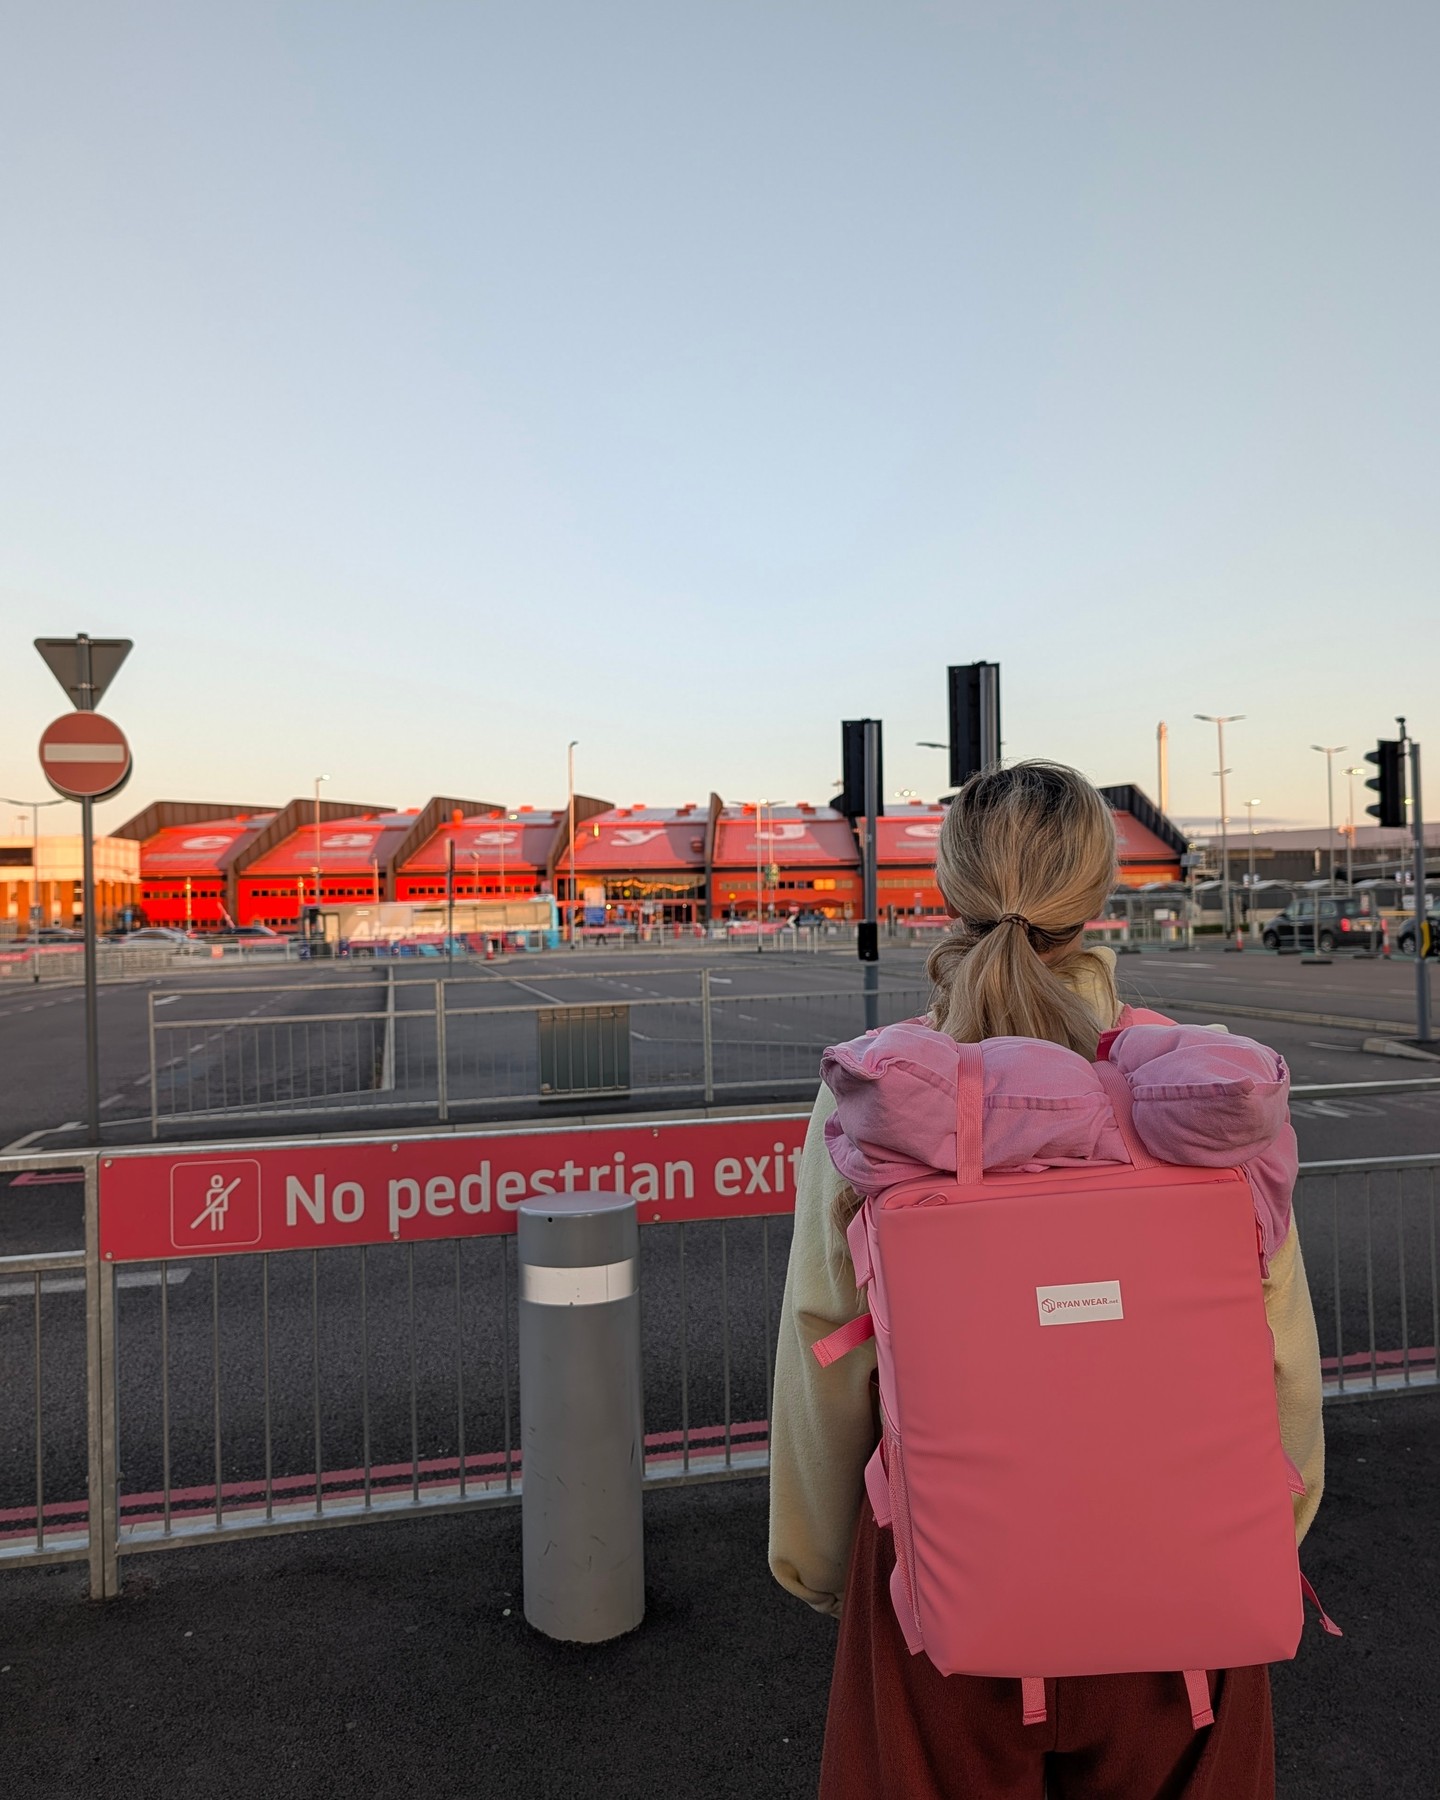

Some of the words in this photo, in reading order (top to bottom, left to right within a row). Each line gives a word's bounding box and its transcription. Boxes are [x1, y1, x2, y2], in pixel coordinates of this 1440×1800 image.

[286, 1173, 365, 1227] No
[388, 1151, 694, 1233] pedestrian
[714, 1141, 803, 1197] exit
[1056, 1299, 1080, 1309] RYAN
